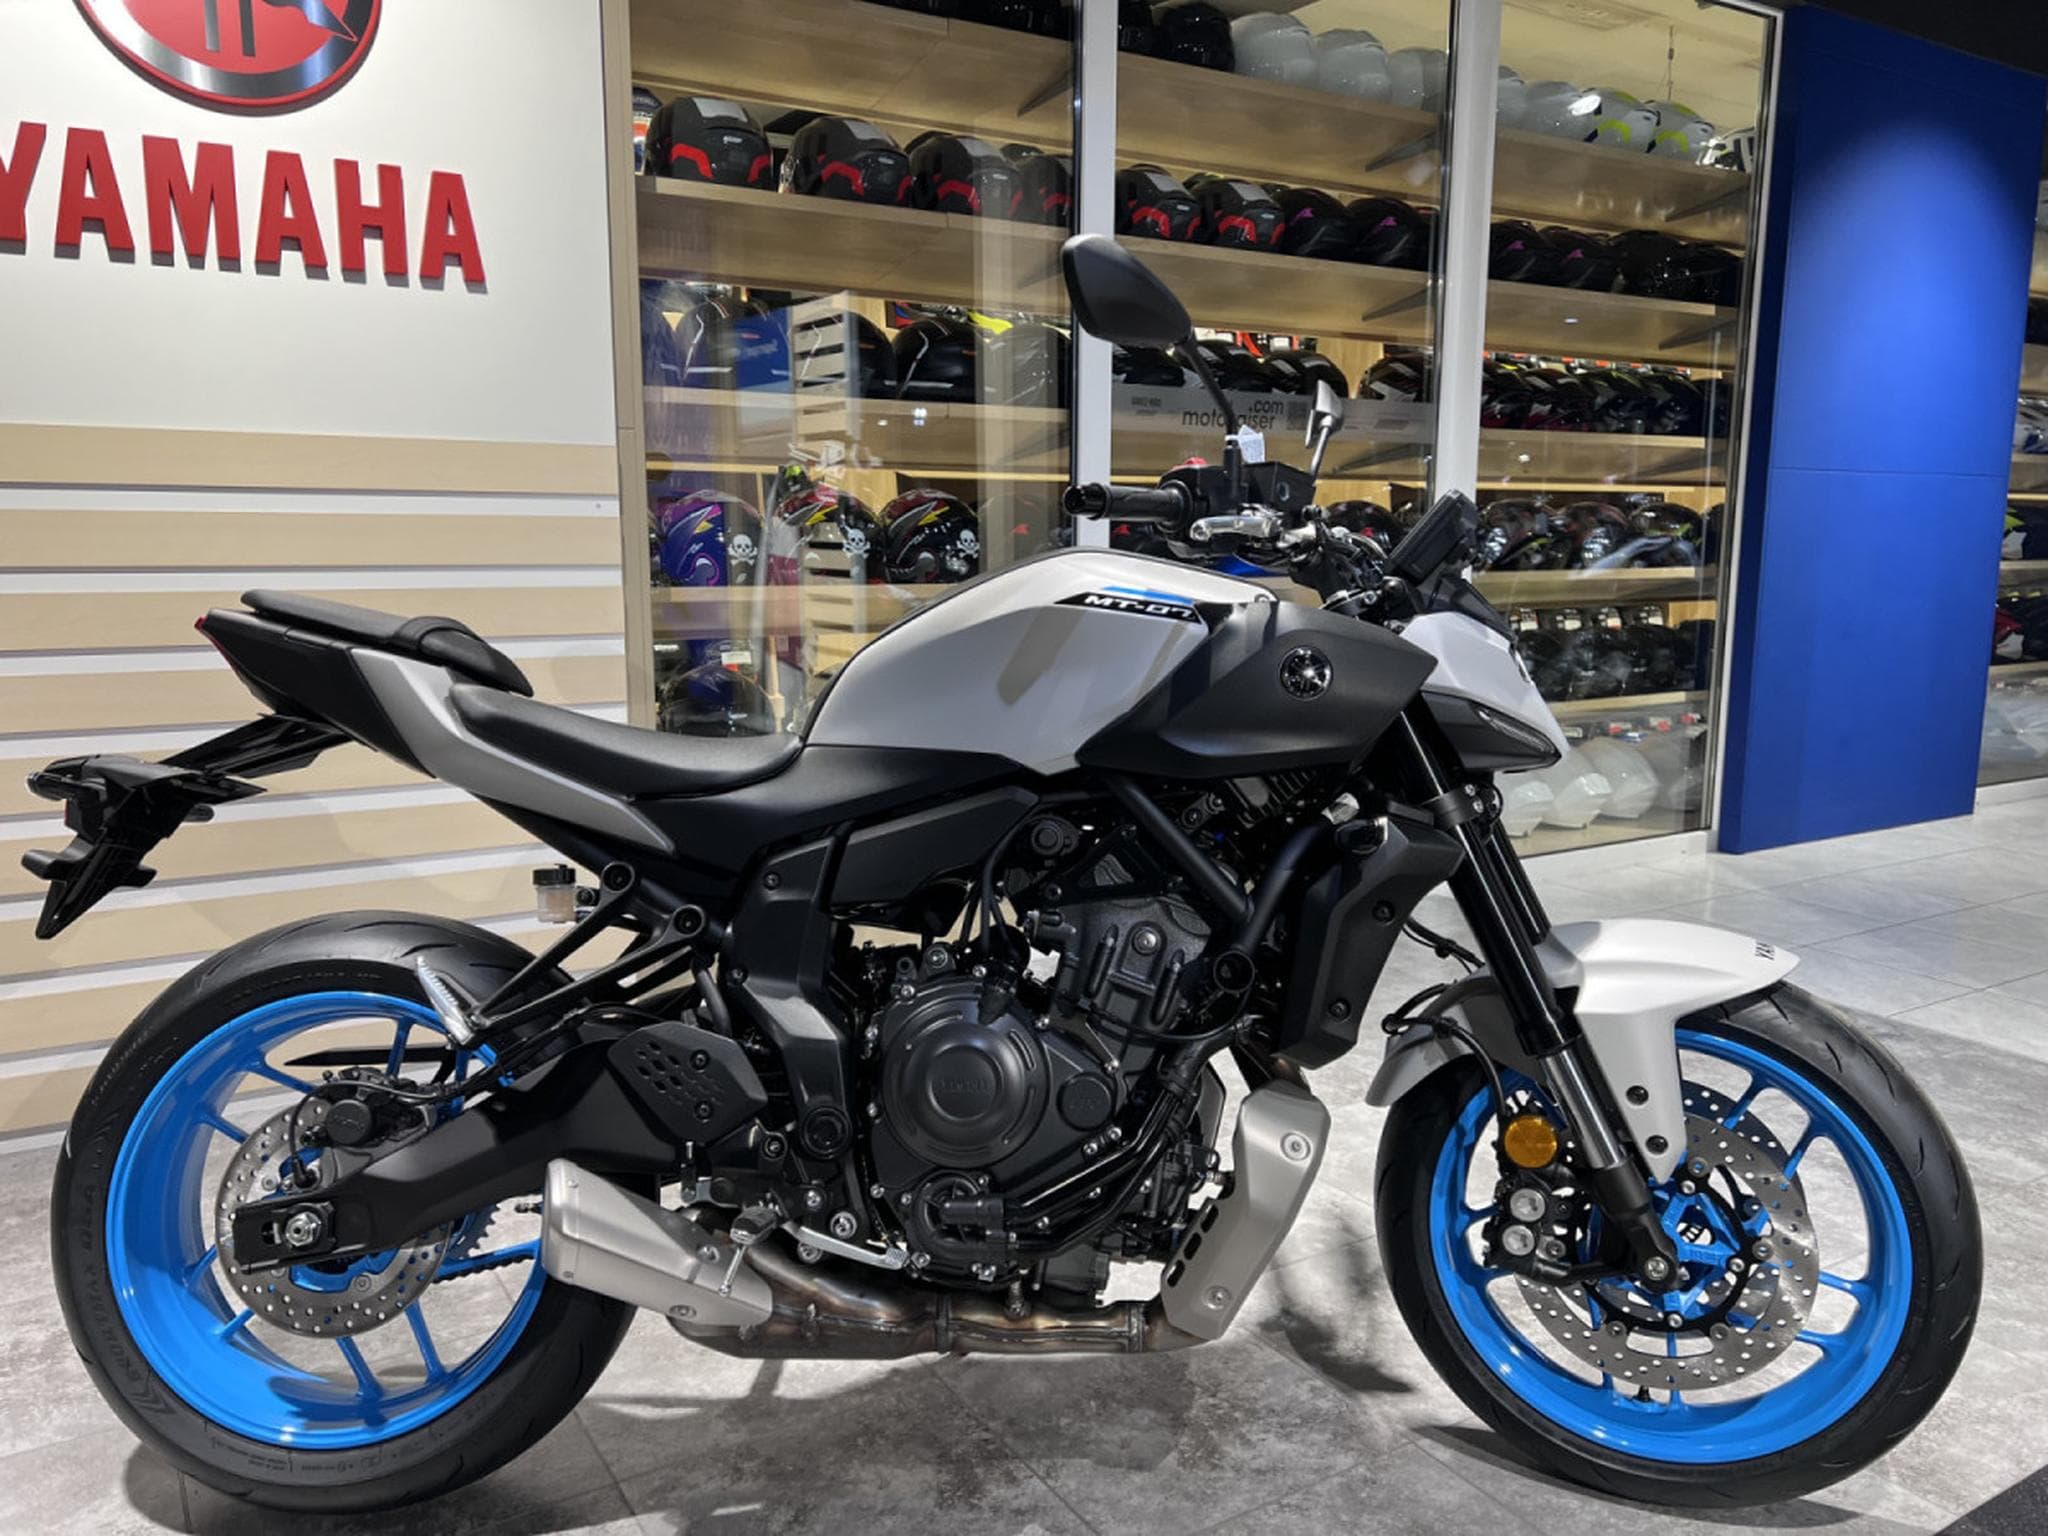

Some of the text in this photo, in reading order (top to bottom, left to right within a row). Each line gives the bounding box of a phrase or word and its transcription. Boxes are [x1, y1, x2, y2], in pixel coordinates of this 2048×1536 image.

[0, 121, 487, 289] YAMAHA
[1181, 408, 1276, 430] motoaiser
[1248, 400, 1285, 415] .com
[1083, 594, 1194, 618] MT-07
